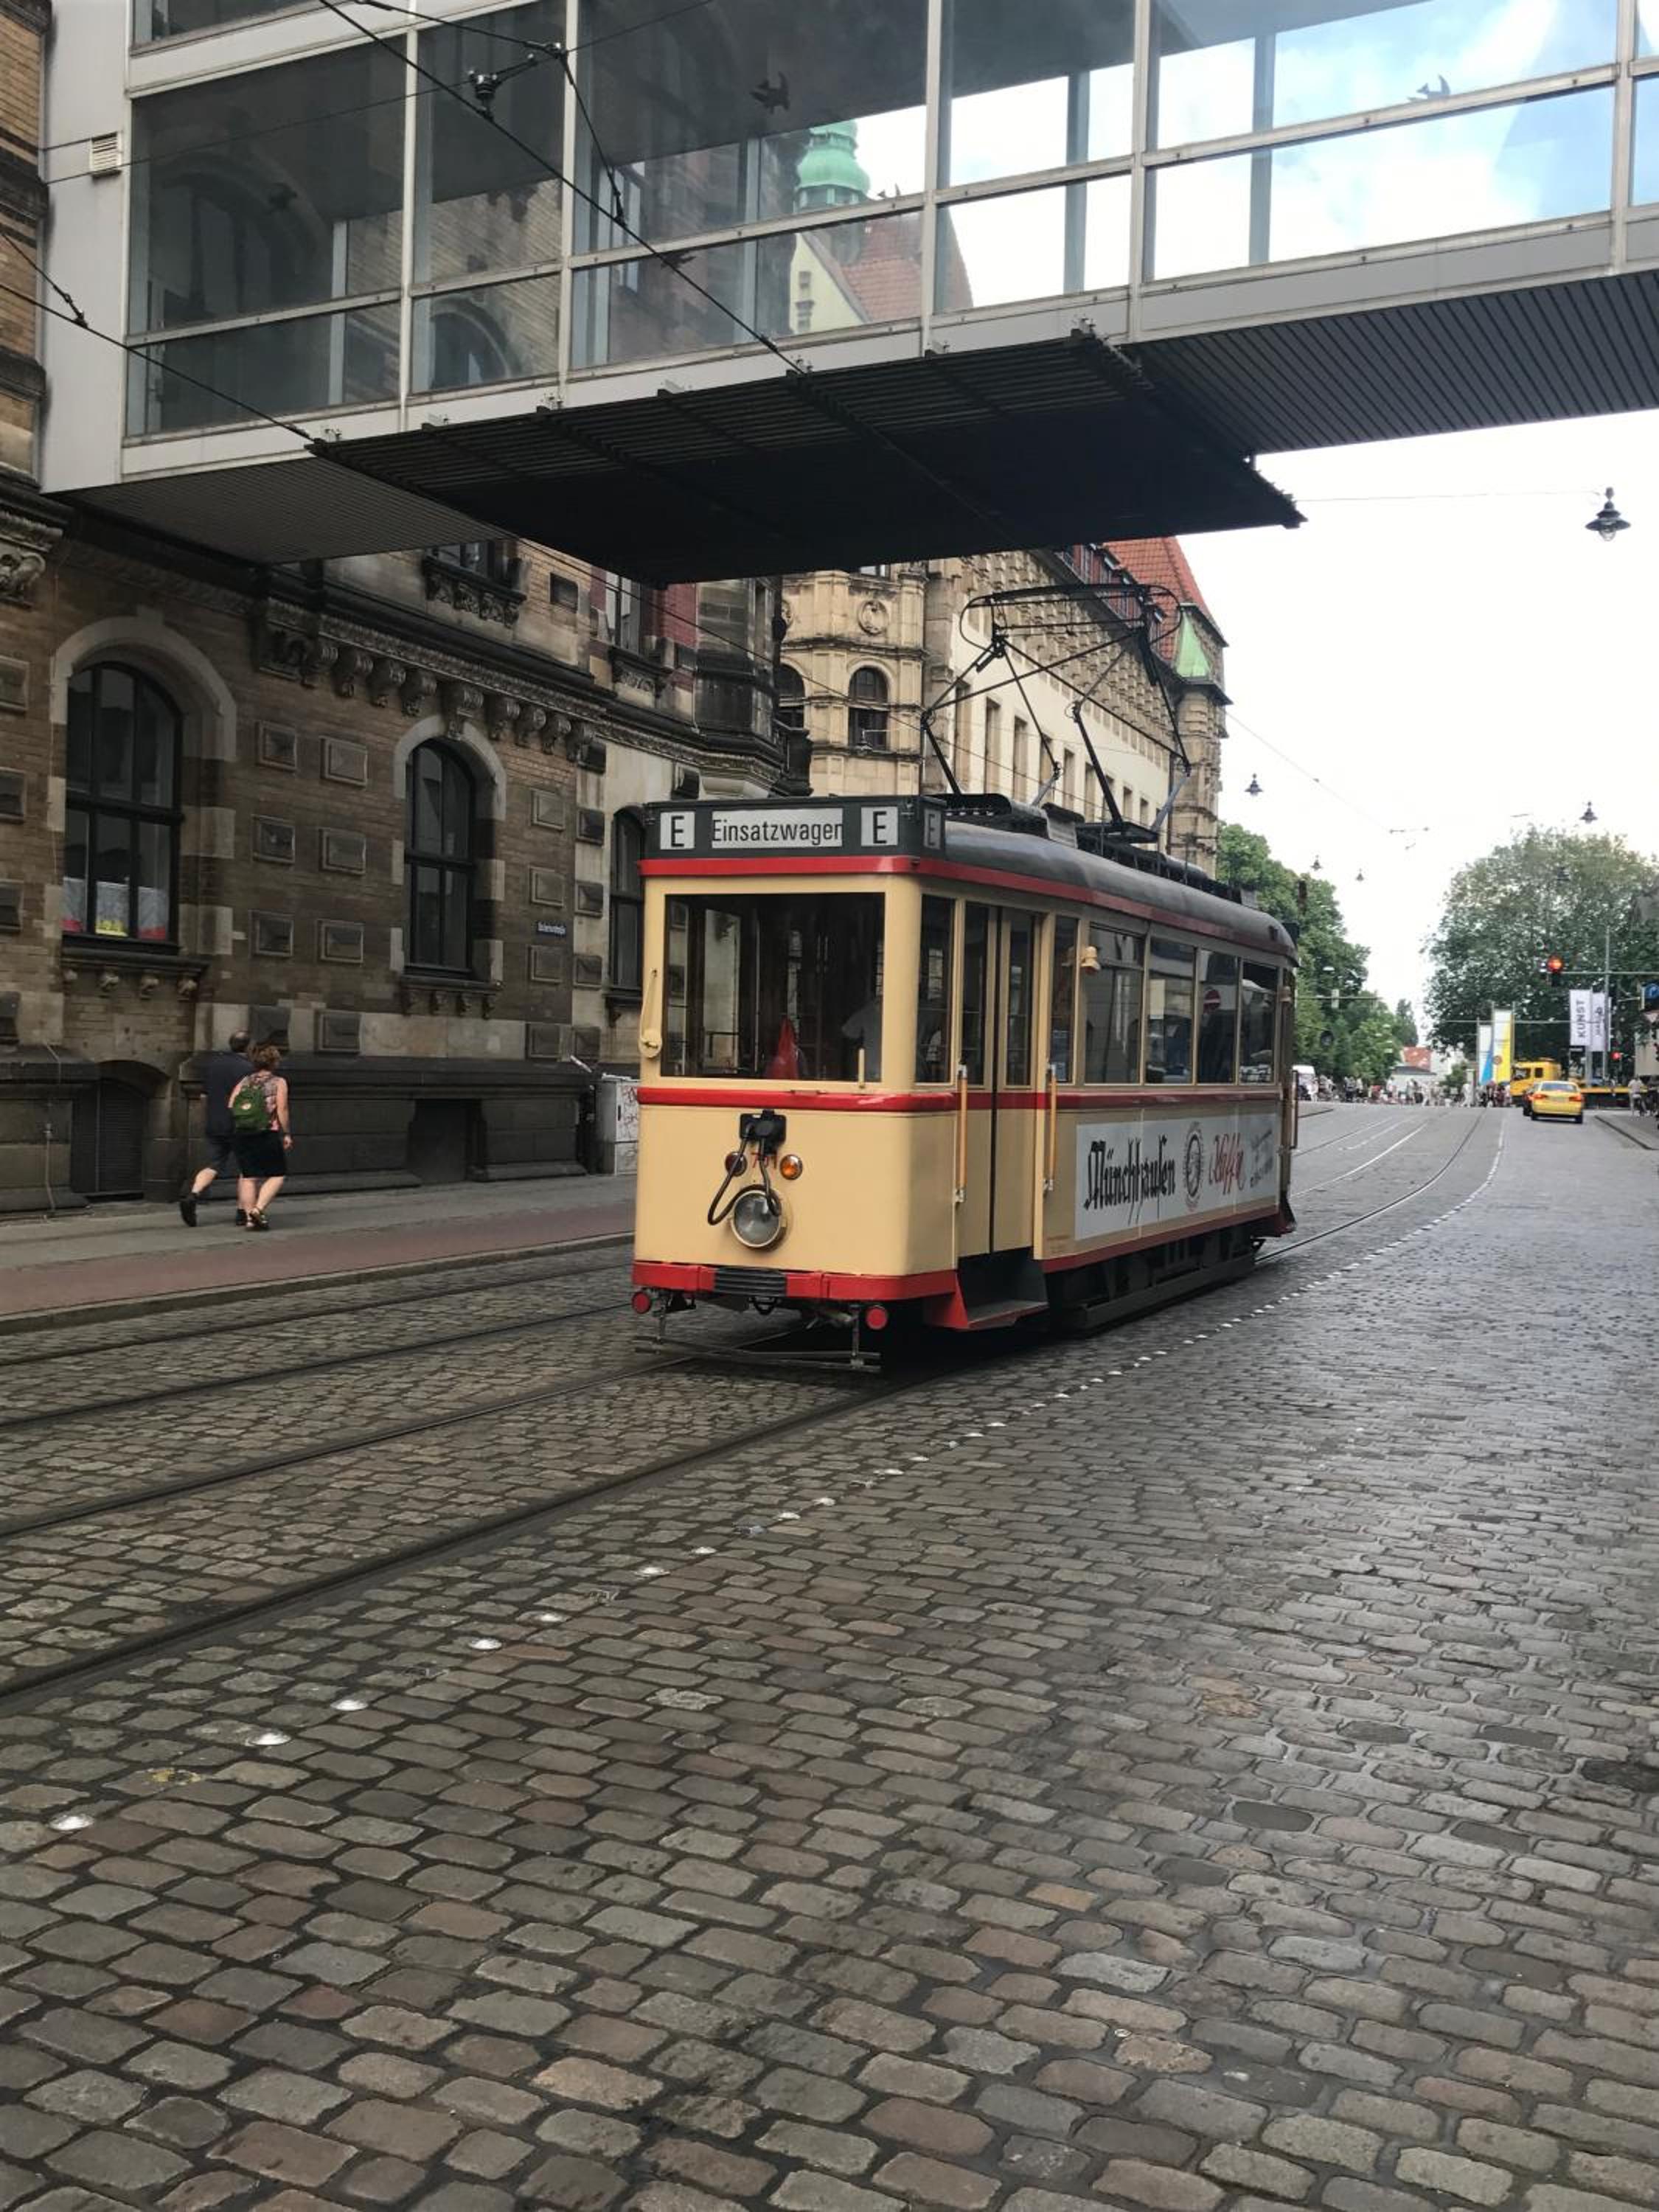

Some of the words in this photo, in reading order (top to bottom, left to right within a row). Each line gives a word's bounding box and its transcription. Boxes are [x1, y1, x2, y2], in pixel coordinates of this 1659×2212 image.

[671, 815, 685, 847] E
[712, 819, 844, 846] Einsatzwagen
[873, 810, 888, 844] E
[927, 813, 937, 846] E
[1576, 999, 1586, 1038] KUNST
